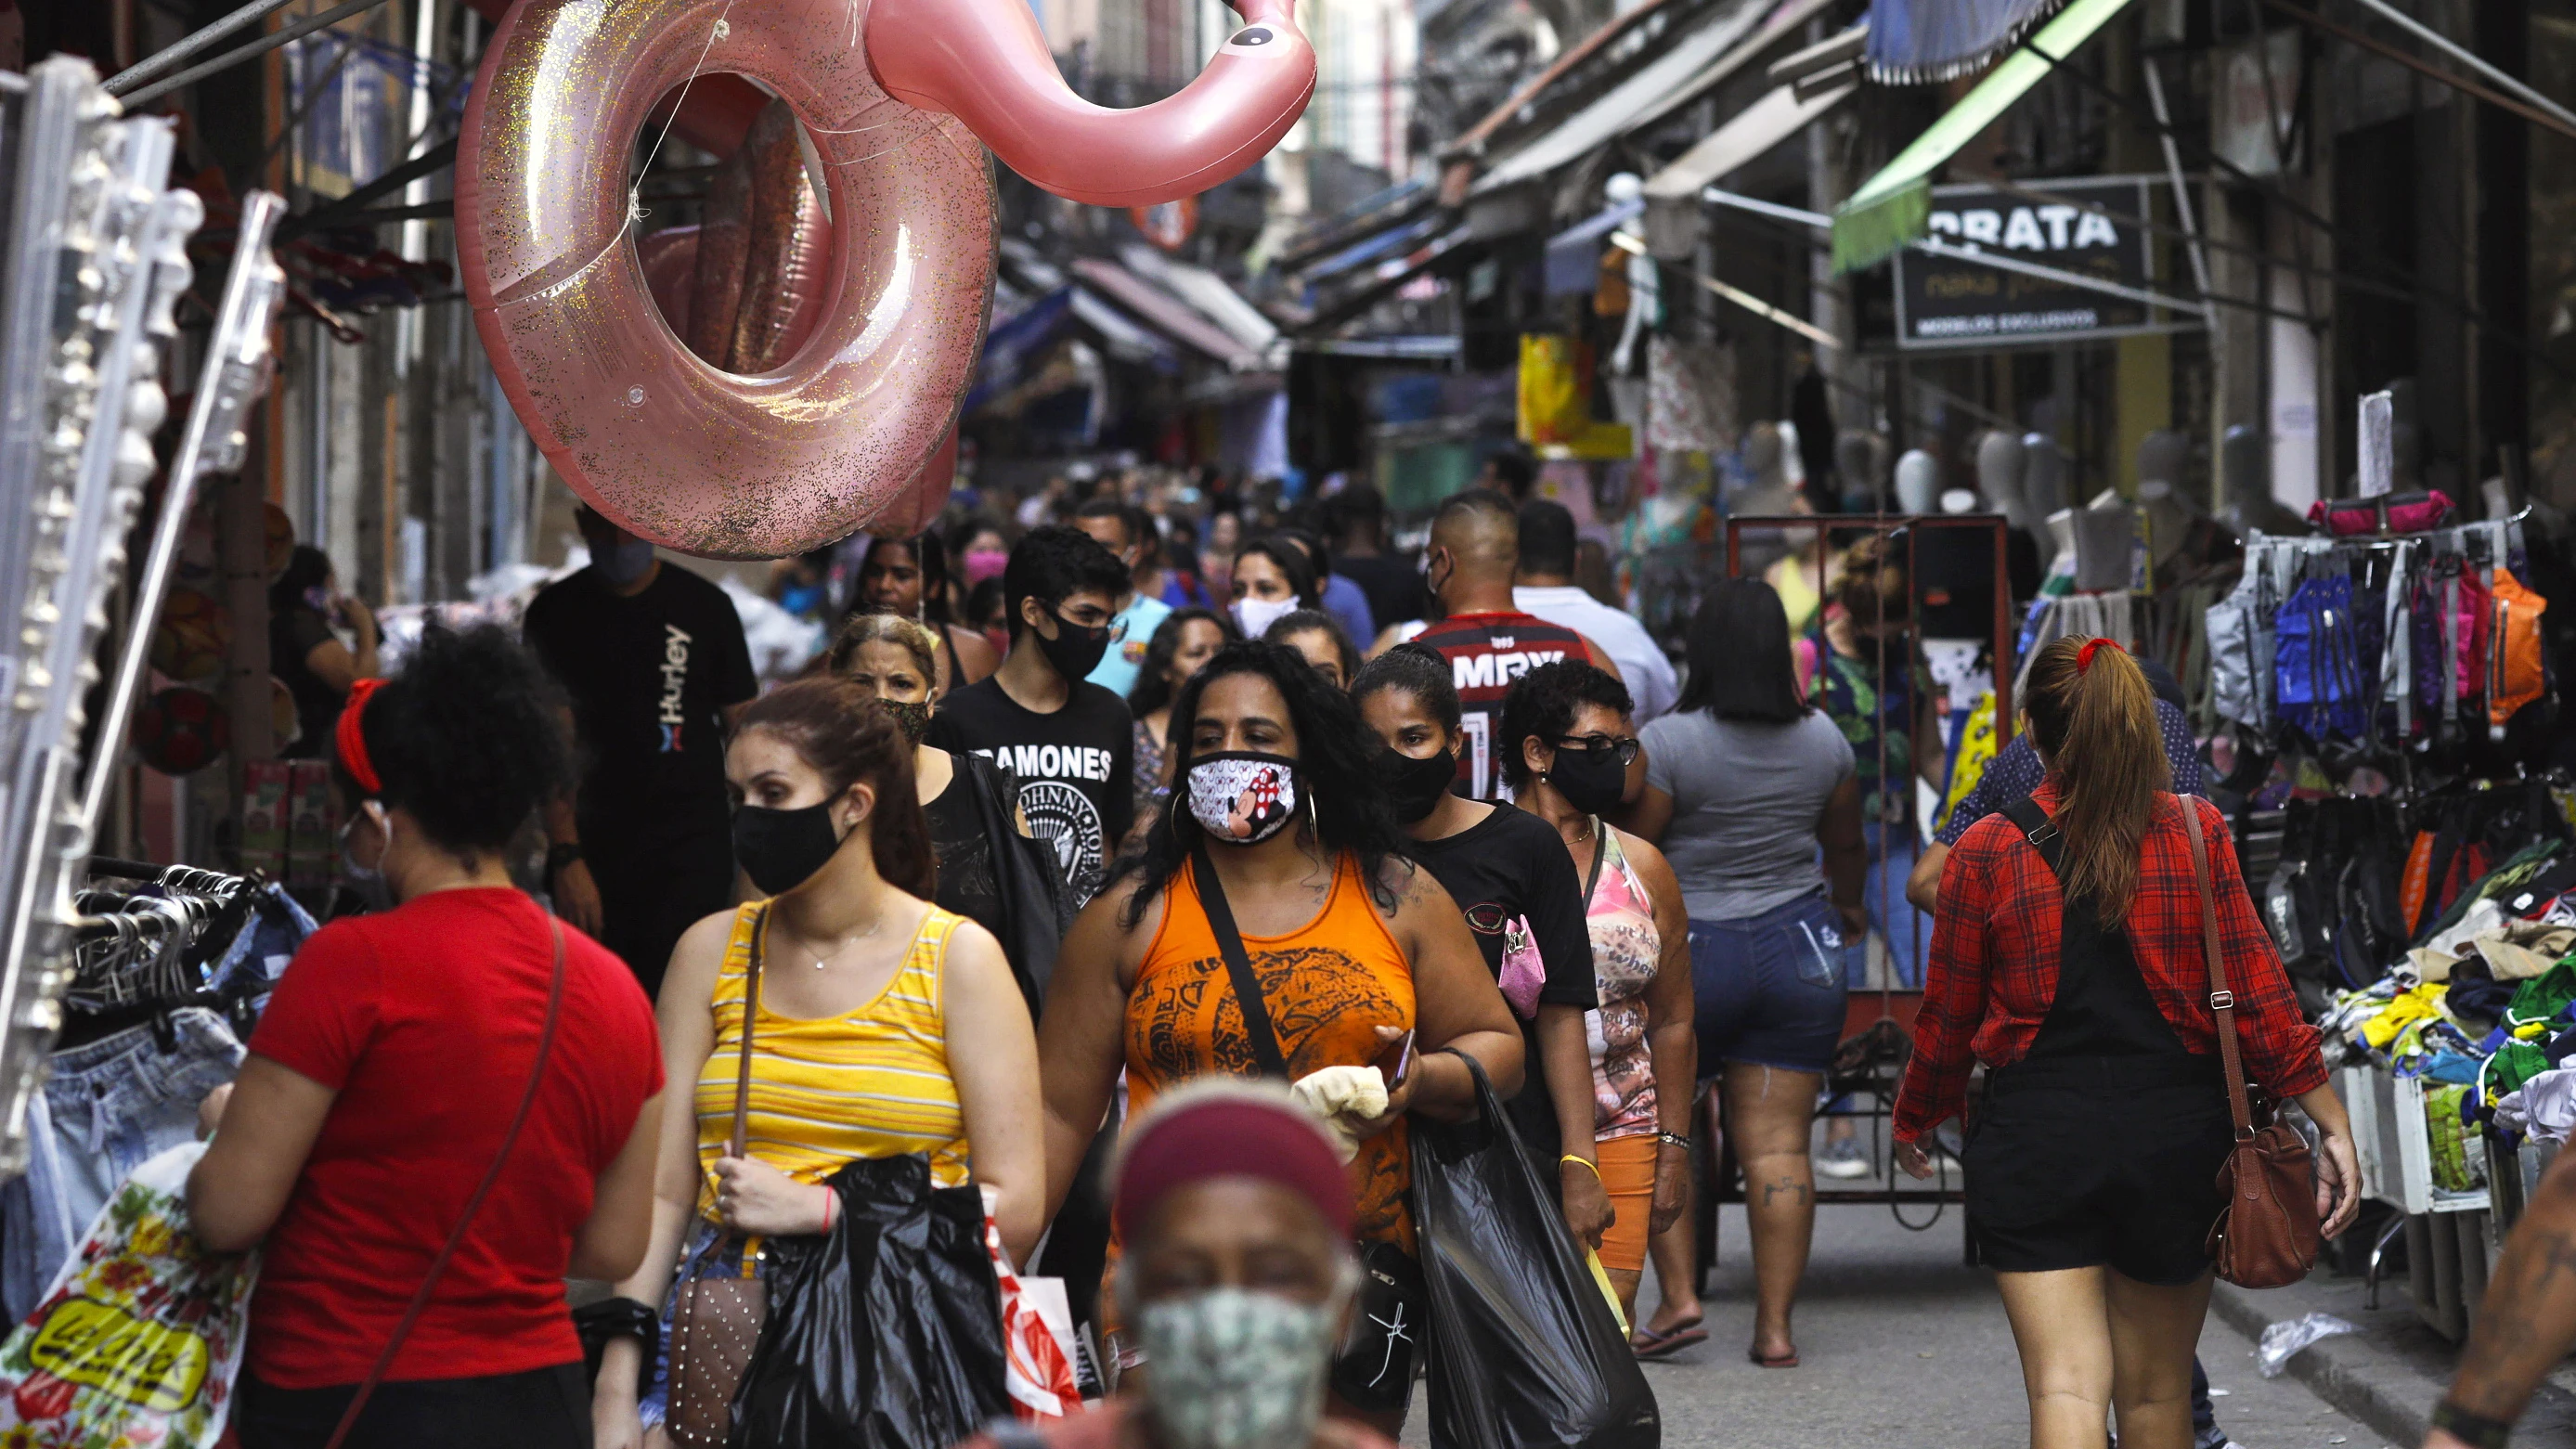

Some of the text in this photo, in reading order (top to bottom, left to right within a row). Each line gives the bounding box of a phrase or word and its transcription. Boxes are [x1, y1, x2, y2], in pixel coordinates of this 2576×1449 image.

[1927, 204, 2118, 255] PRATA
[658, 622, 693, 724] Hurley
[1019, 786, 1103, 873] OHNNY JOE
